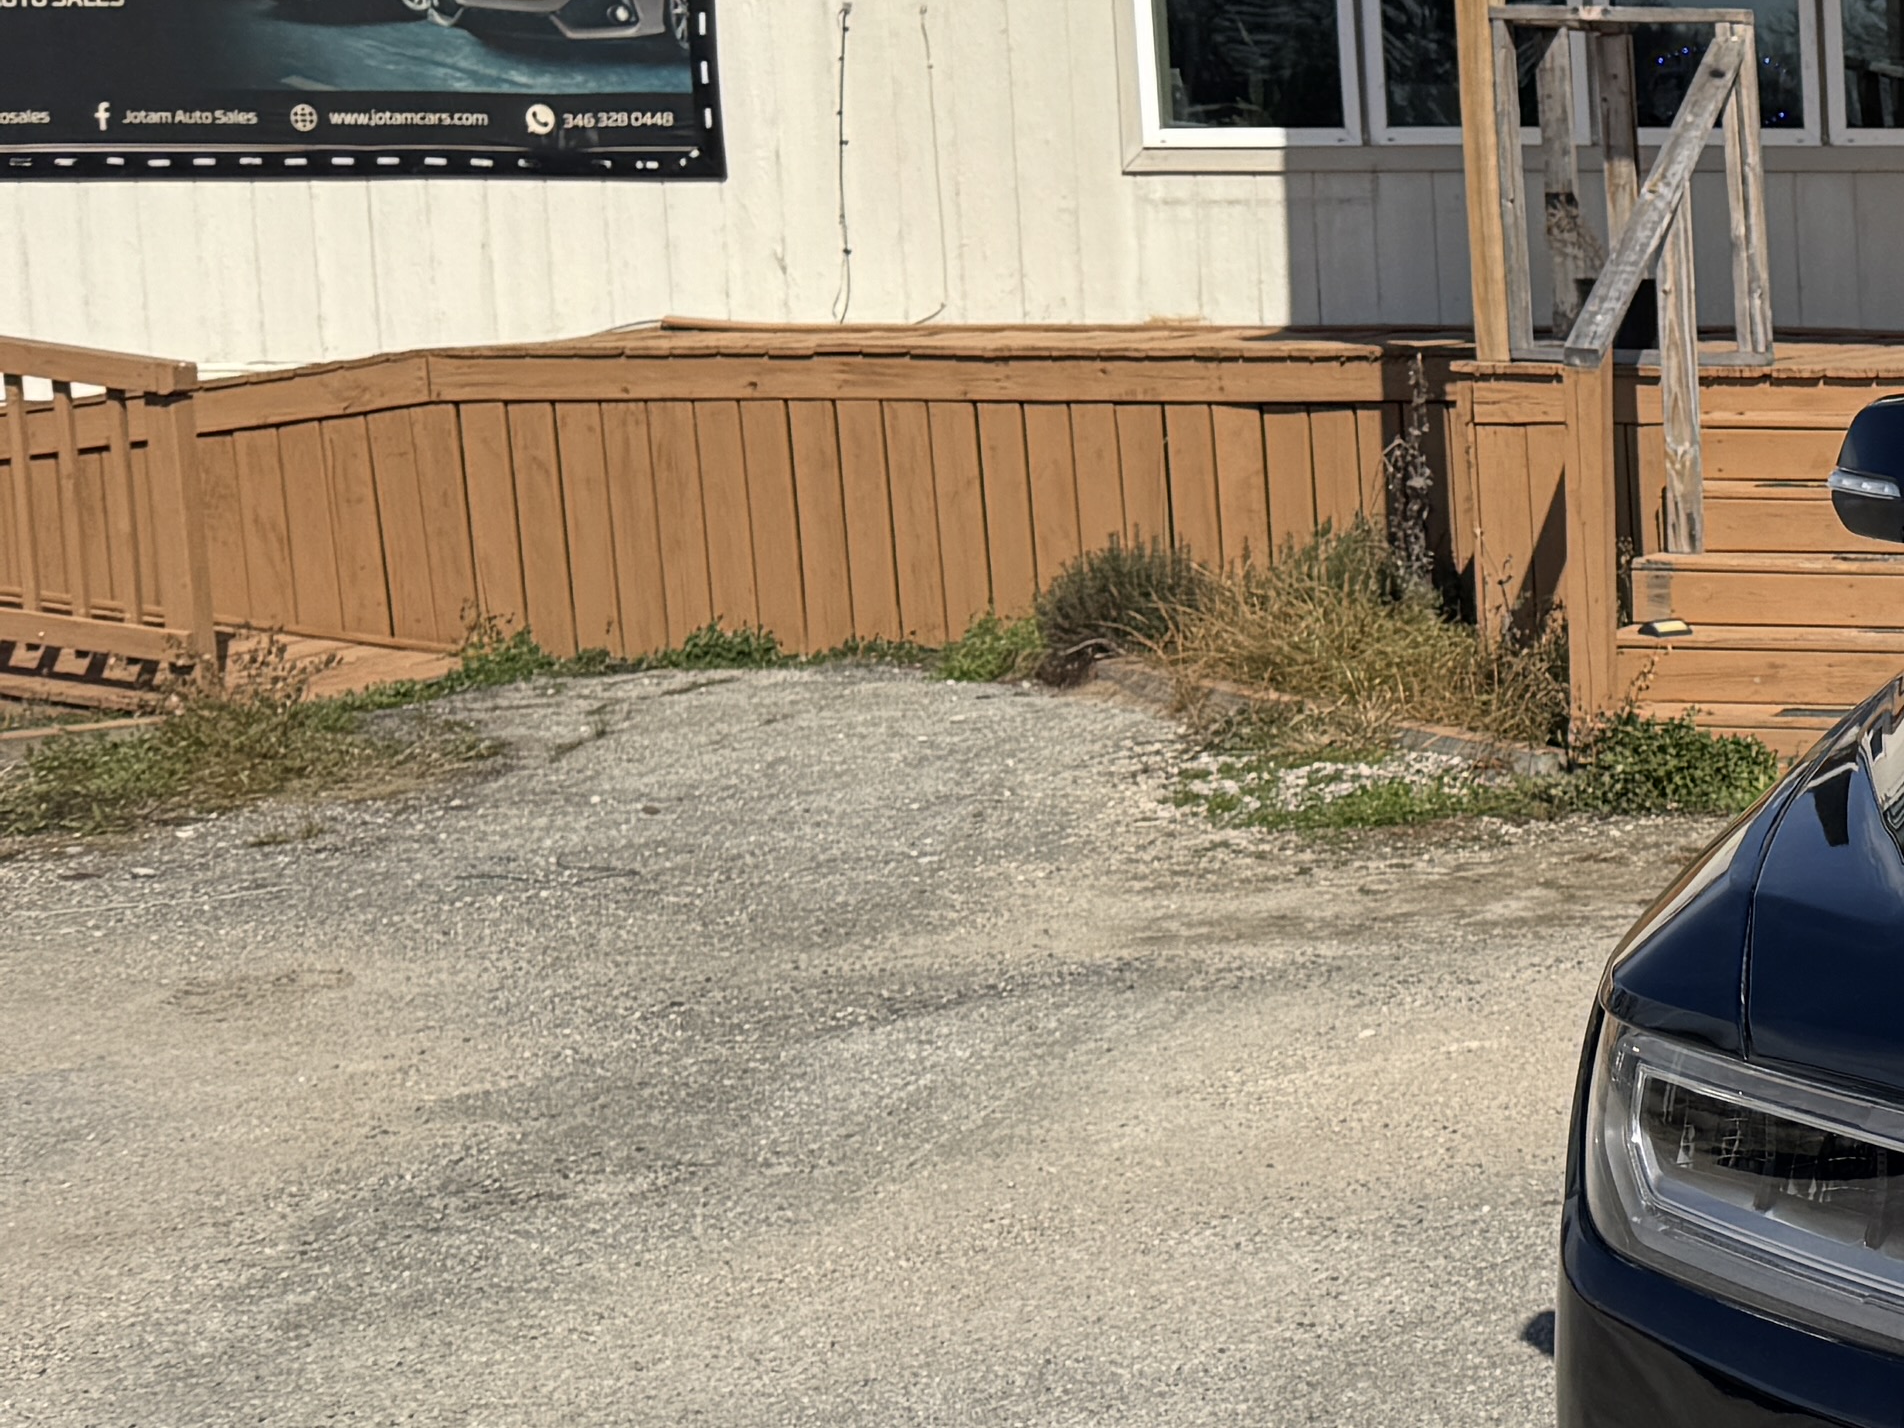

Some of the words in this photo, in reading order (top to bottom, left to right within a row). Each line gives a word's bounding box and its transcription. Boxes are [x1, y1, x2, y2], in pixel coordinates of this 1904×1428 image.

[122, 109, 171, 124] Jotam
[174, 109, 212, 124] Auto
[214, 109, 258, 125] Sales
[328, 109, 489, 127] www.jotamcars.com
